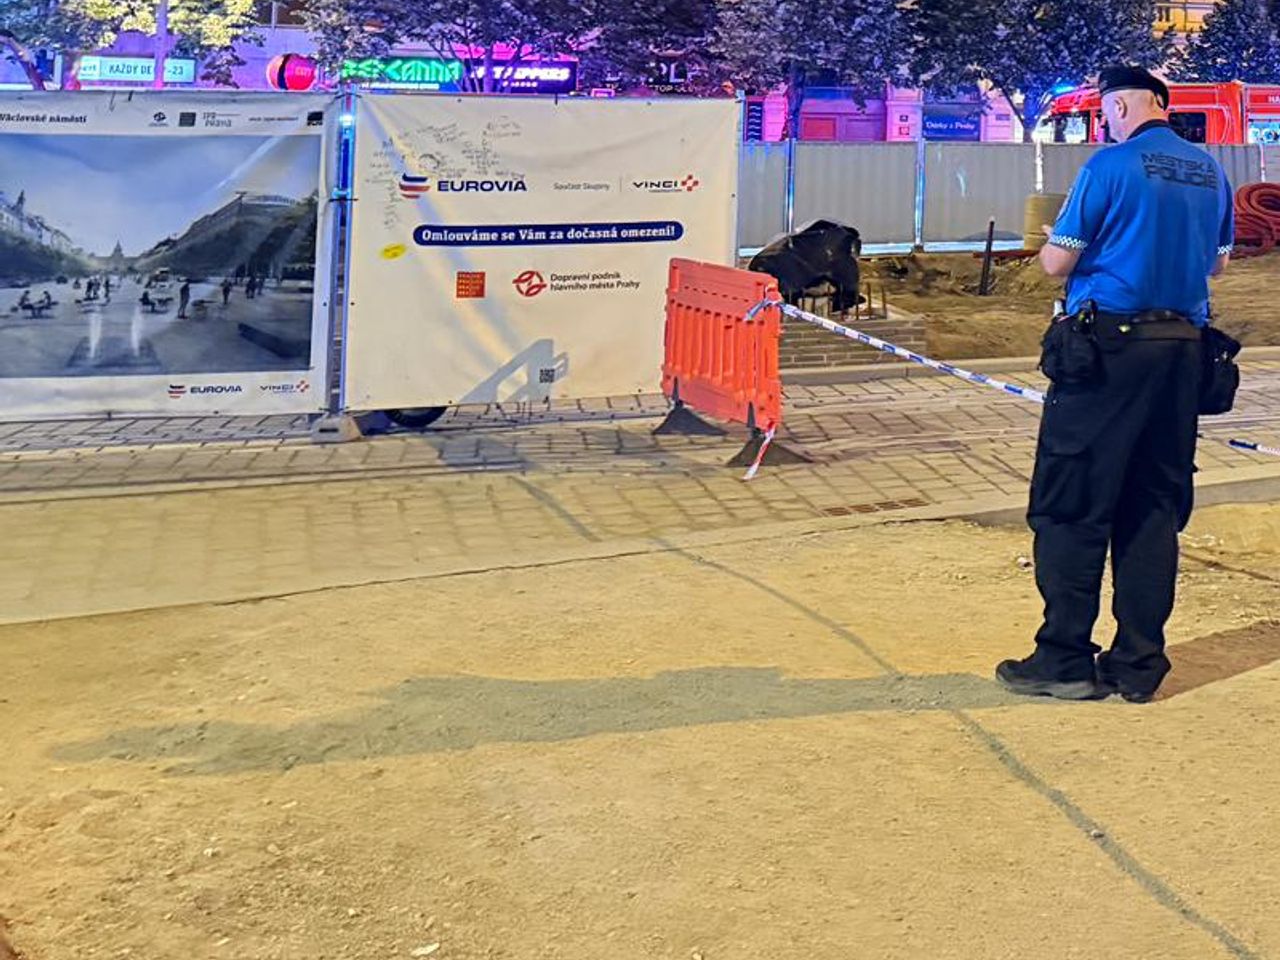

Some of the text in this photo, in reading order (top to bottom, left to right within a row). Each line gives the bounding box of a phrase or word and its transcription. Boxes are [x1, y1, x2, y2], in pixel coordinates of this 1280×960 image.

[1144, 164, 1217, 190] POLICIE
[437, 180, 528, 192] EUROVIA
[632, 180, 678, 189] VINCI
[422, 225, 675, 241] Omlouváme se Vám za dočasná omezení!
[550, 271, 620, 283] Dopravní podnik
[616, 280, 640, 290] Prahy
[190, 385, 242, 394] EUROVIA
